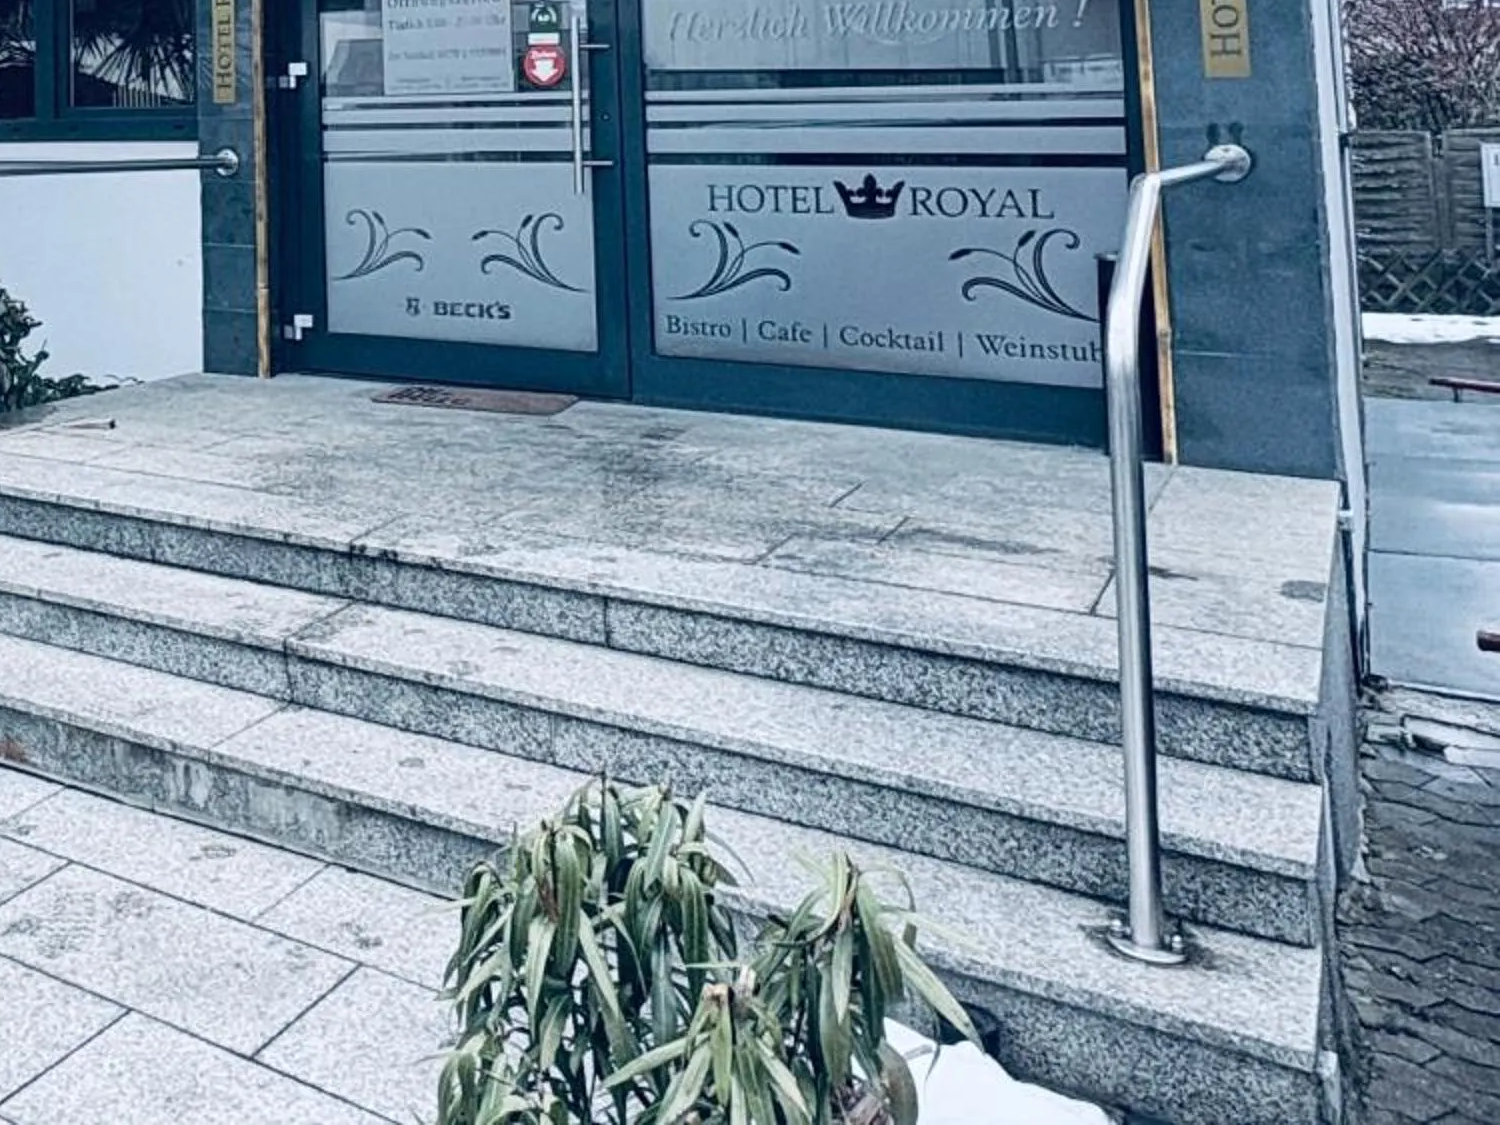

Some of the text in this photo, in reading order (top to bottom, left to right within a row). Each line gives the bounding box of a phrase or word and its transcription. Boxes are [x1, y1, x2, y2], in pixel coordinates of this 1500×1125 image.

[668, 1, 808, 43] Herzlich
[217, 13, 232, 89] HOTEL
[706, 184, 1056, 220] HOTEL ROYAL
[666, 314, 1101, 365] Bistro Cafe Cocktail Weinstub
